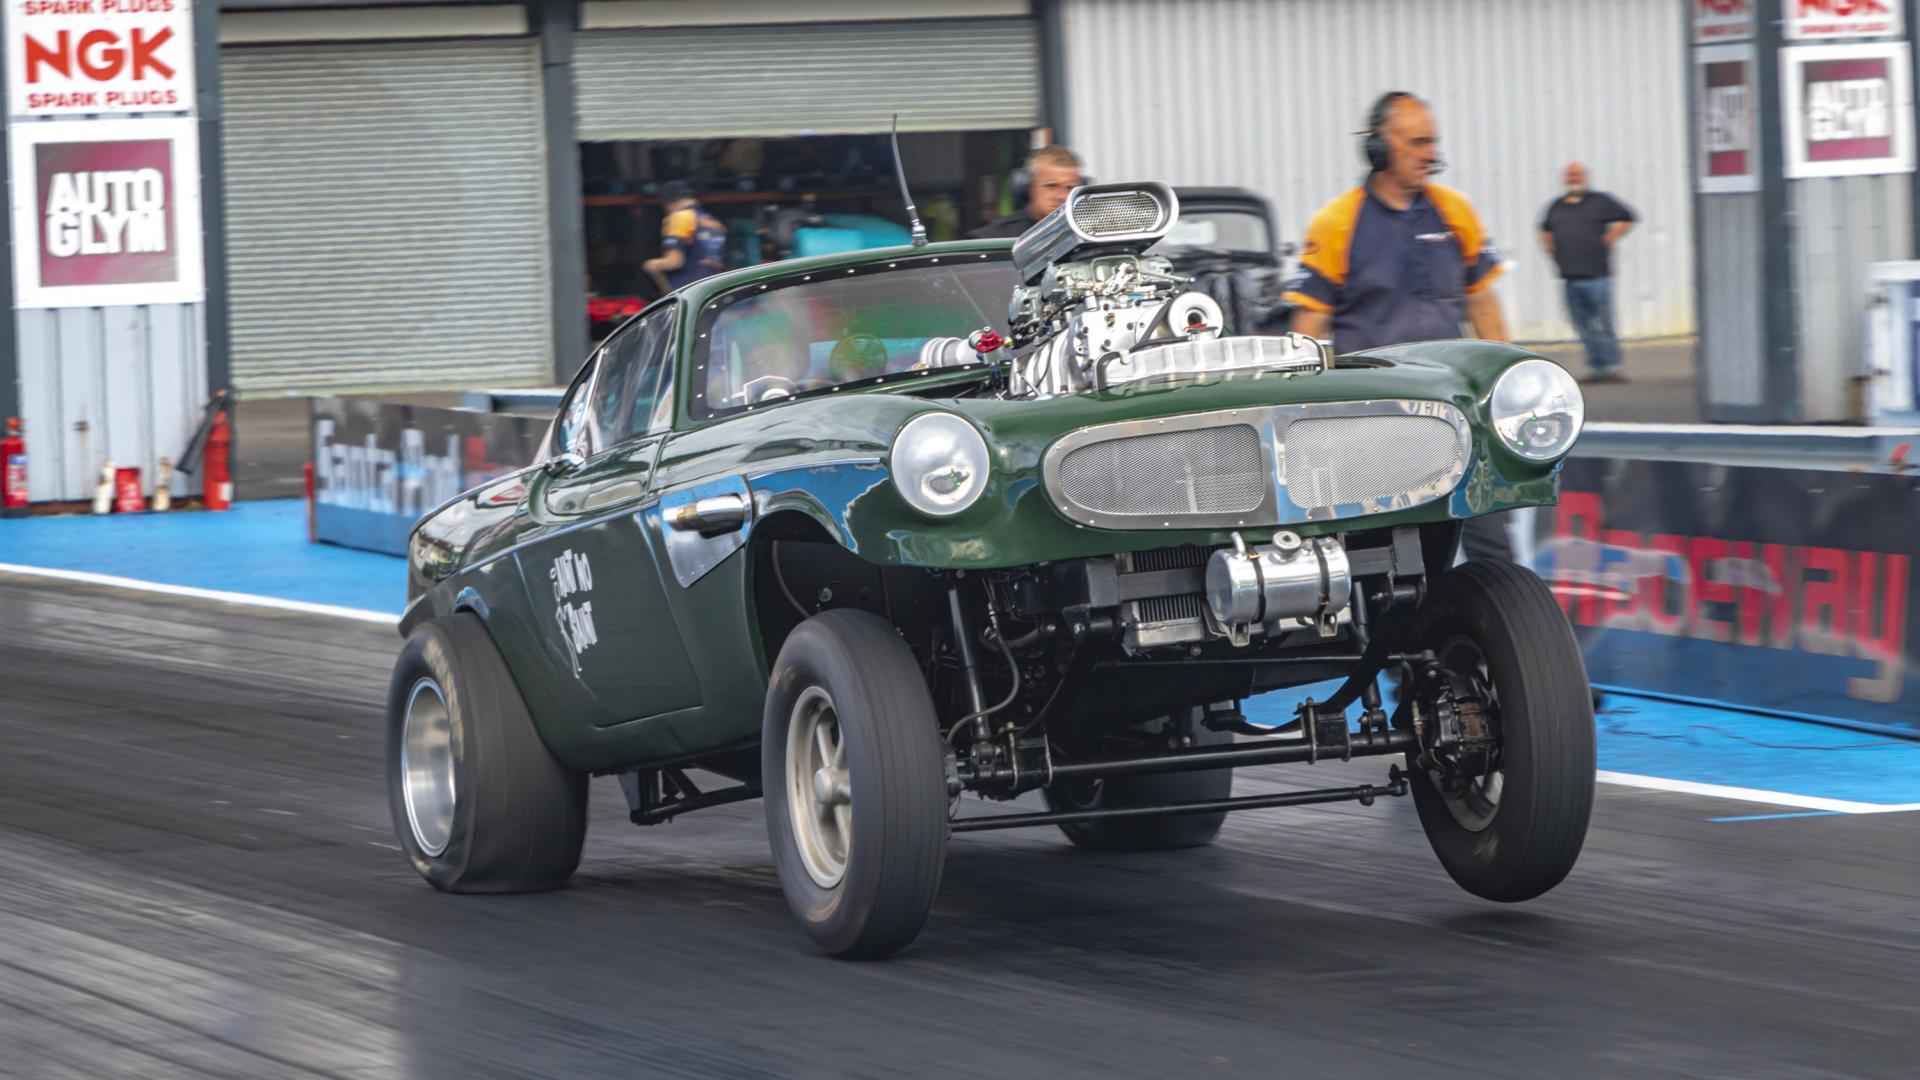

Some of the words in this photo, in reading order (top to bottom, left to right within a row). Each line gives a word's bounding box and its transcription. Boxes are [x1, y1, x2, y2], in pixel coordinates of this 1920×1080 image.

[23, 25, 177, 84] NGK
[27, 92, 98, 109] SPARK
[105, 89, 178, 106] PLUGS
[46, 167, 165, 215] AUTO
[46, 207, 168, 258] GLYM
